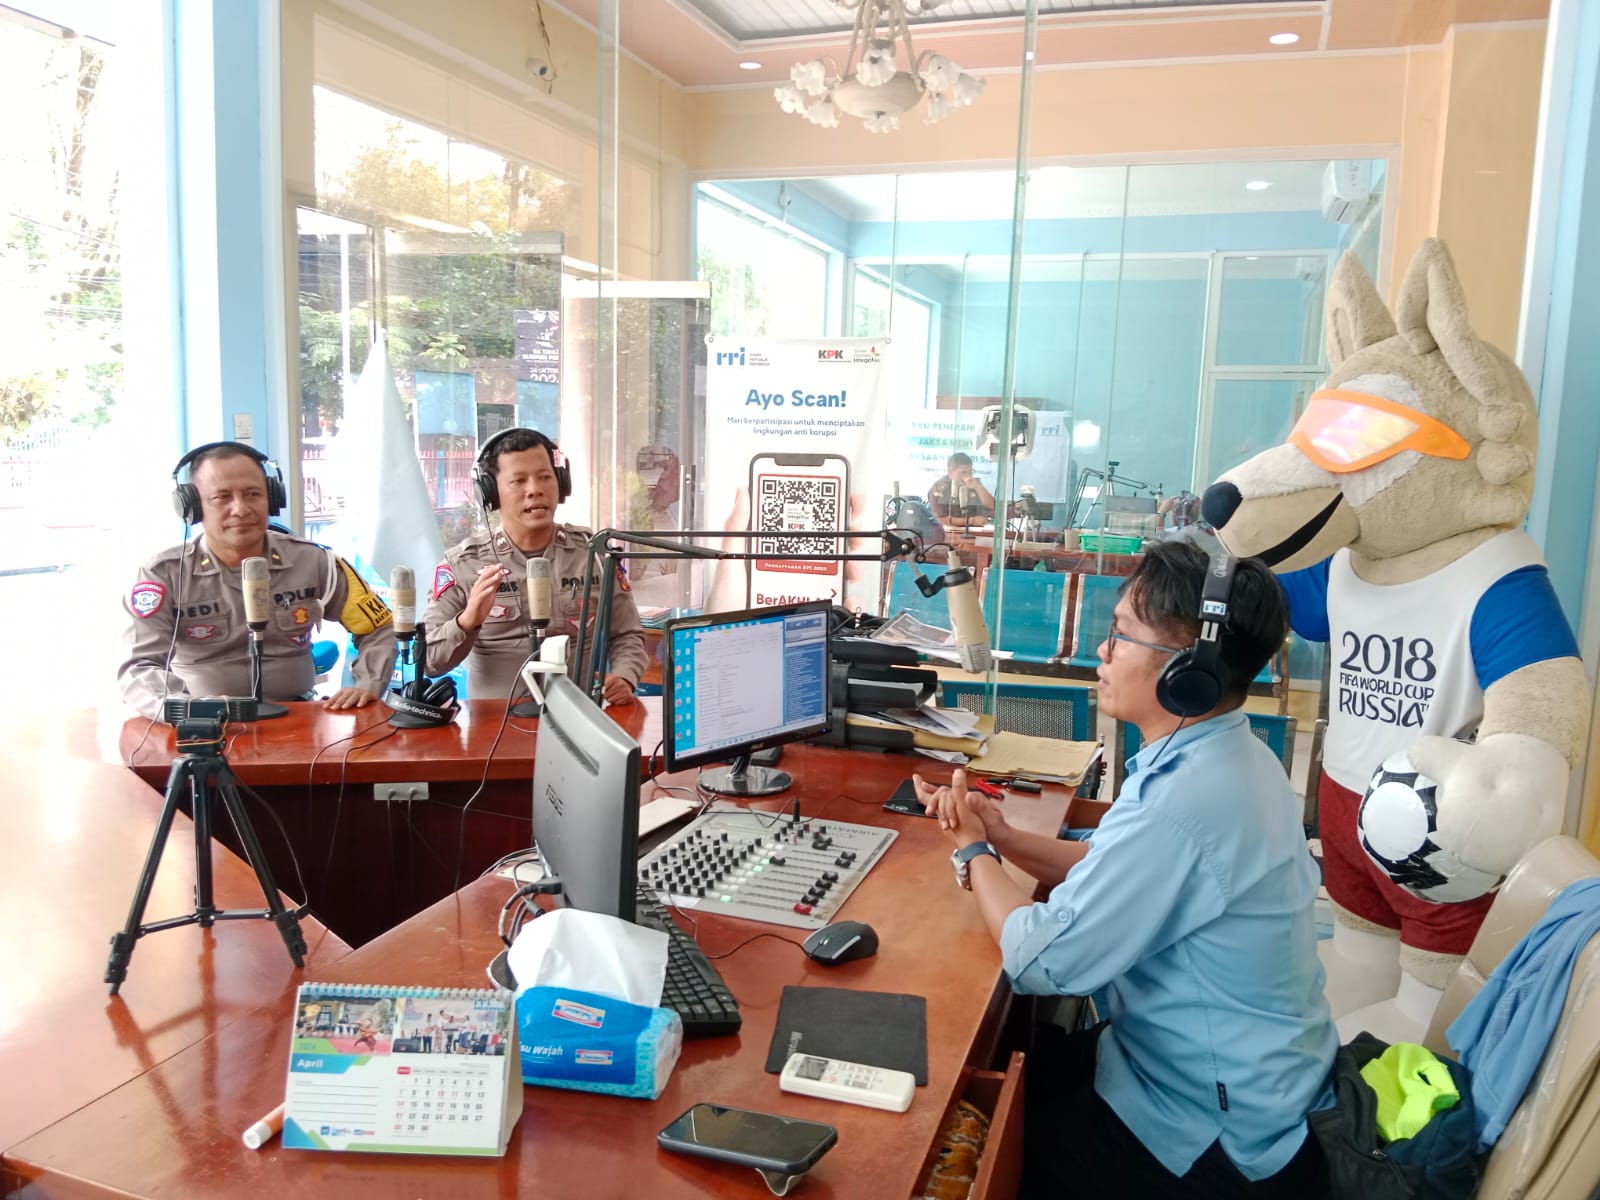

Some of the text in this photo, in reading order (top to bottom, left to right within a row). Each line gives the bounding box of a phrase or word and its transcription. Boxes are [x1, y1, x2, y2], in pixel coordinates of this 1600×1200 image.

[717, 347, 746, 366] rri
[818, 349, 844, 359] KPK
[529, 373, 560, 384] 202
[745, 388, 847, 410] Ayo Scan!
[727, 416, 865, 429] Mari berpartisipasi untuk menciptakan
[753, 426, 837, 438] lingkungan anti korupsi
[1340, 630, 1437, 682] 2018
[1340, 672, 1435, 701] FIFA WORLD CUP
[1339, 687, 1424, 729] RUSSIA
[296, 1058, 324, 1069] April
